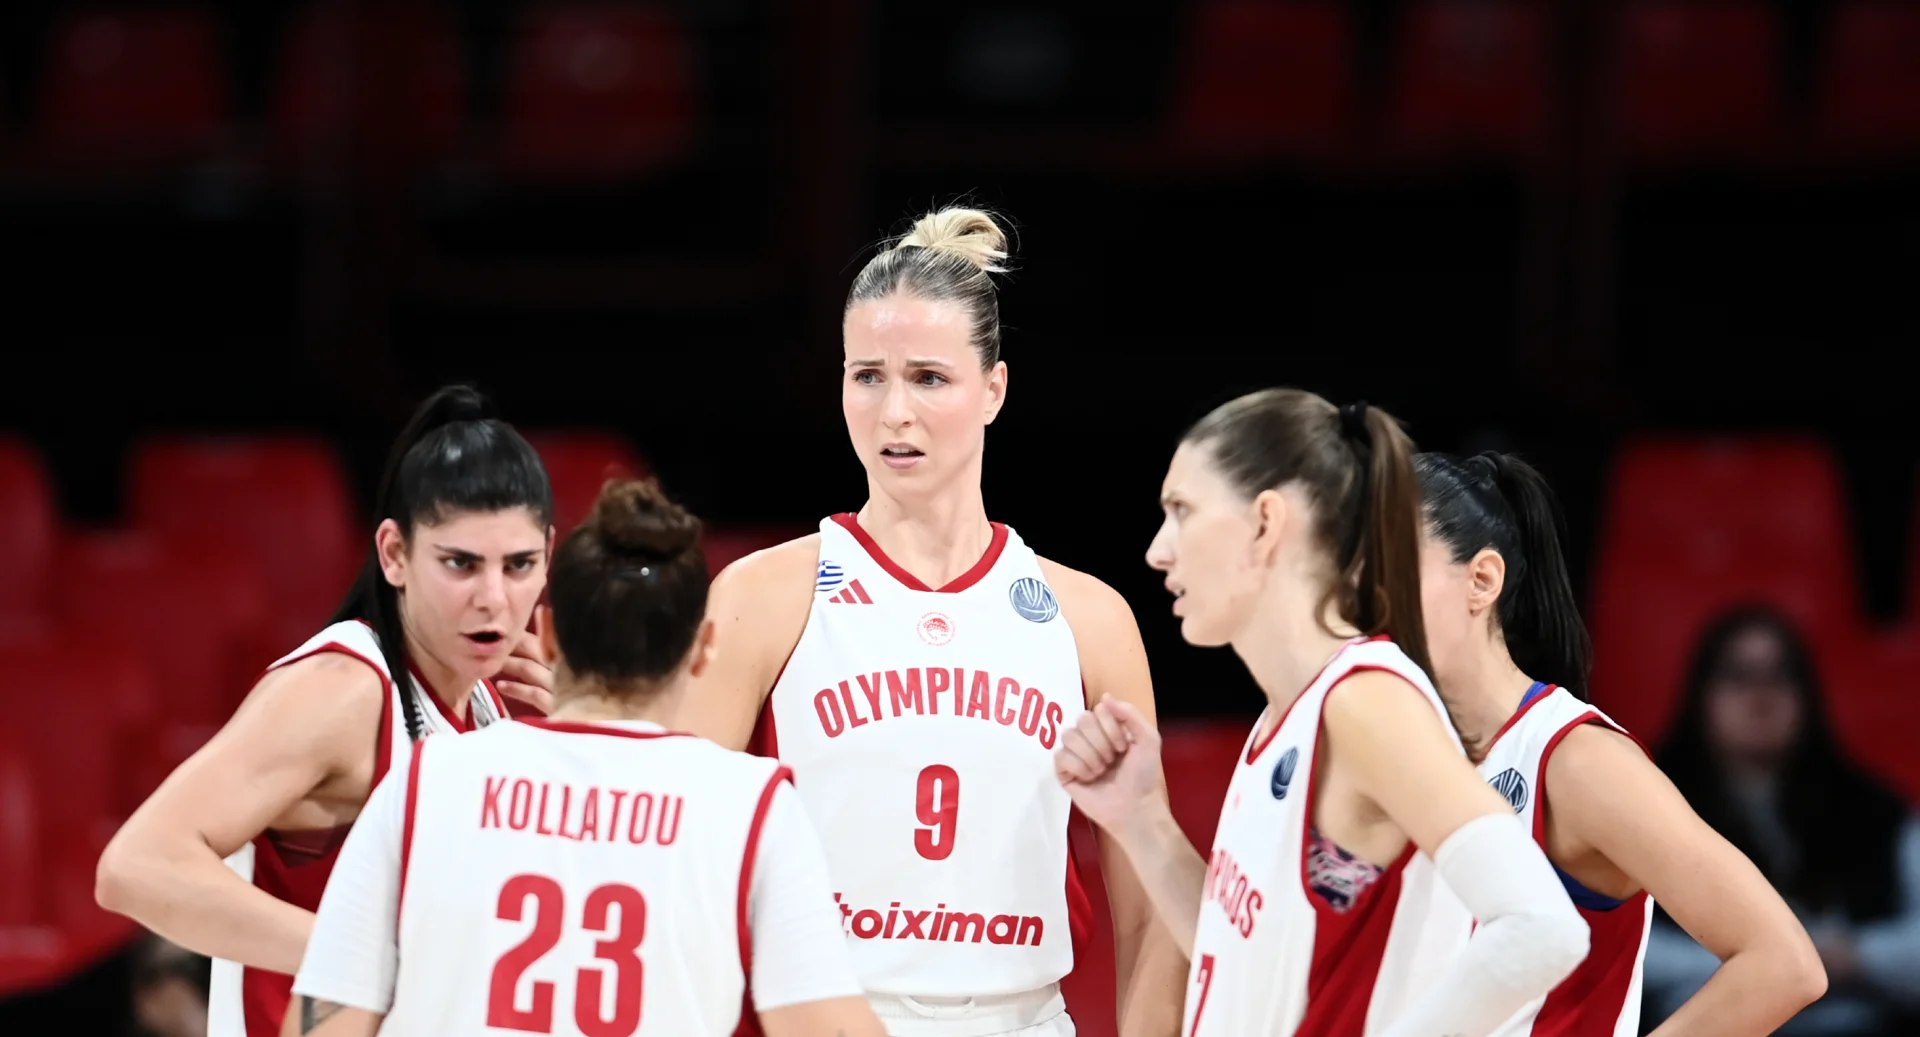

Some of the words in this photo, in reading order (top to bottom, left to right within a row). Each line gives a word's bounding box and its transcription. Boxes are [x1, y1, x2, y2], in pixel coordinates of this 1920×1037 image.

[814, 666, 1063, 750] OLYMPIACOS
[480, 776, 684, 846] KOLLATOU
[914, 764, 960, 861] 9
[486, 873, 648, 1037] 23
